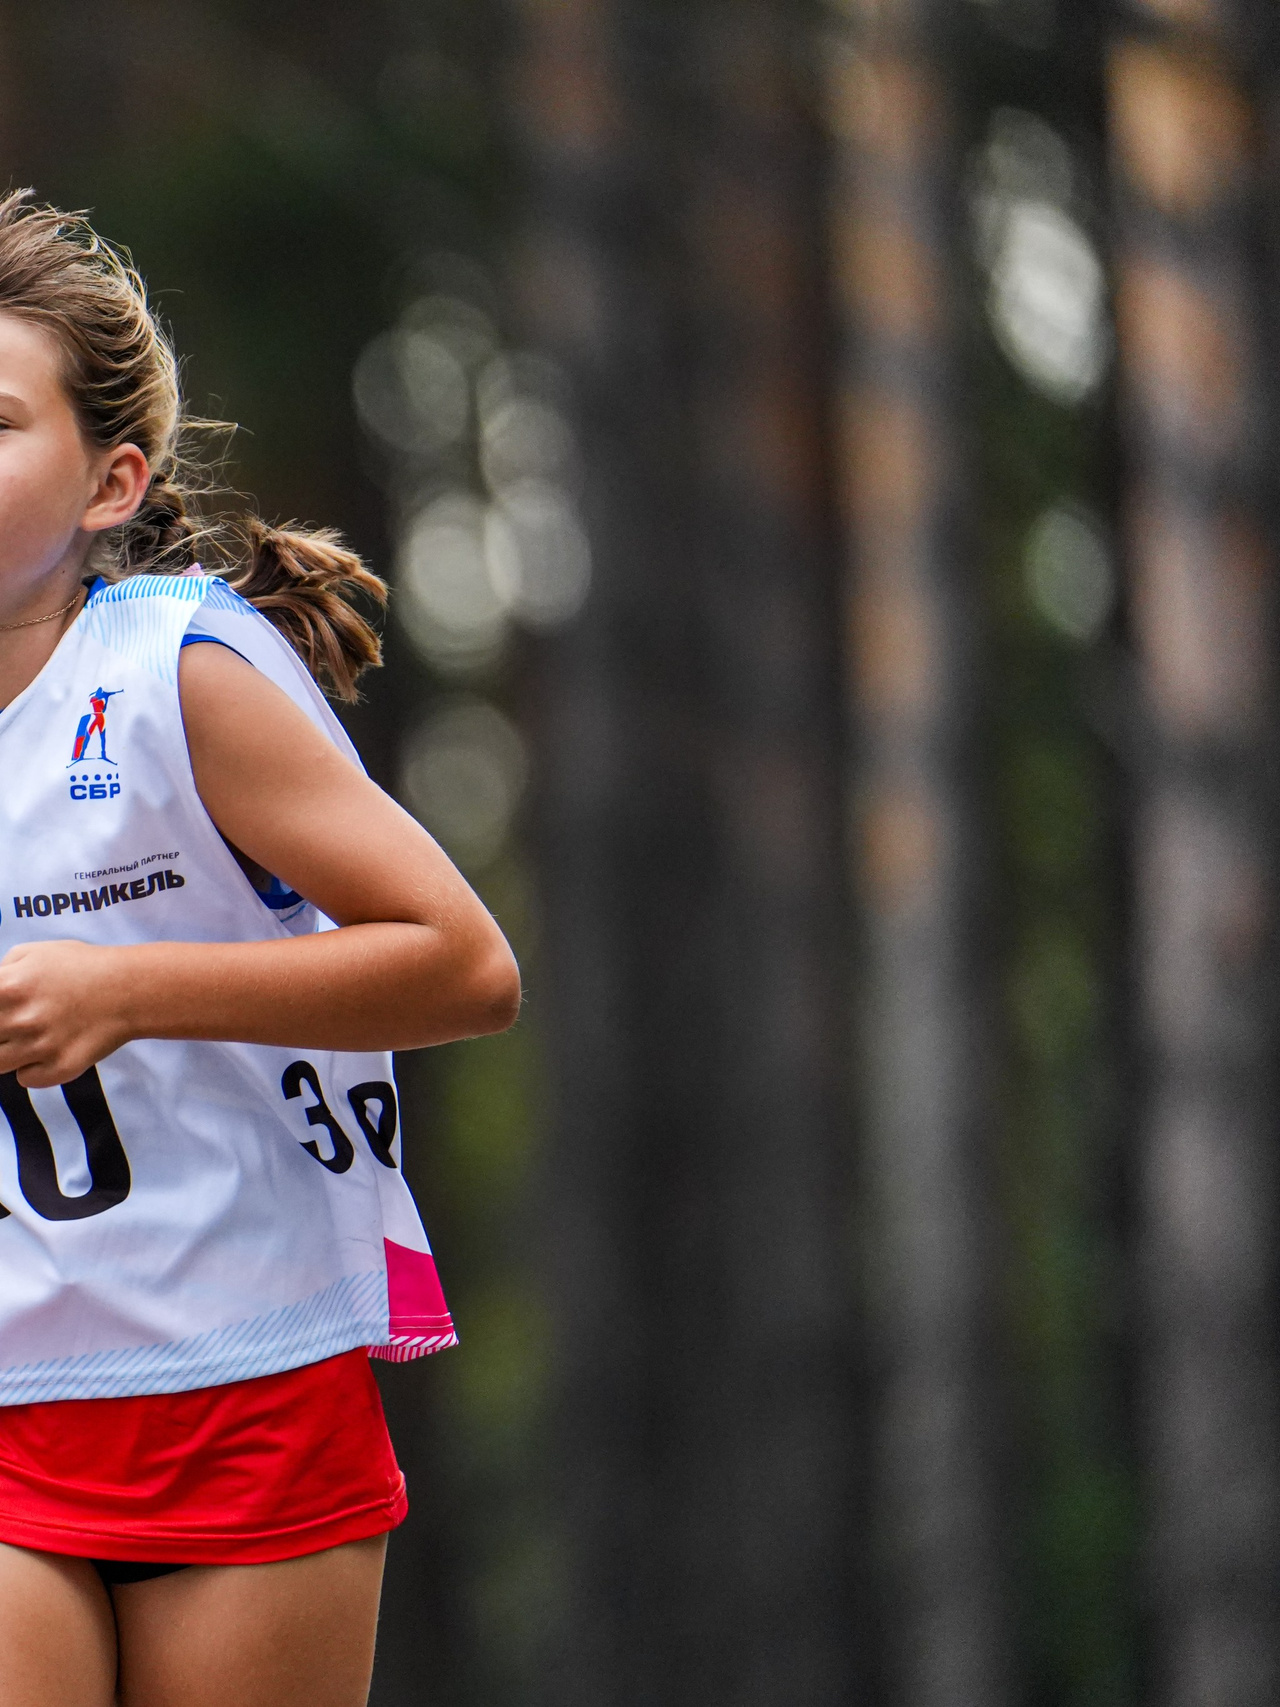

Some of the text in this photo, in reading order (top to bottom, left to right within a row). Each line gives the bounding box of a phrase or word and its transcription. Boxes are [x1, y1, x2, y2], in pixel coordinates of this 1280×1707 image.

[70, 783, 121, 800] СБР
[74, 851, 180, 880] ГЕНЕРАЛЬНЫЙ ПАРТНЕР
[13, 870, 185, 917] НОРНИКЕЛЬ
[281, 1060, 397, 1174] 30
